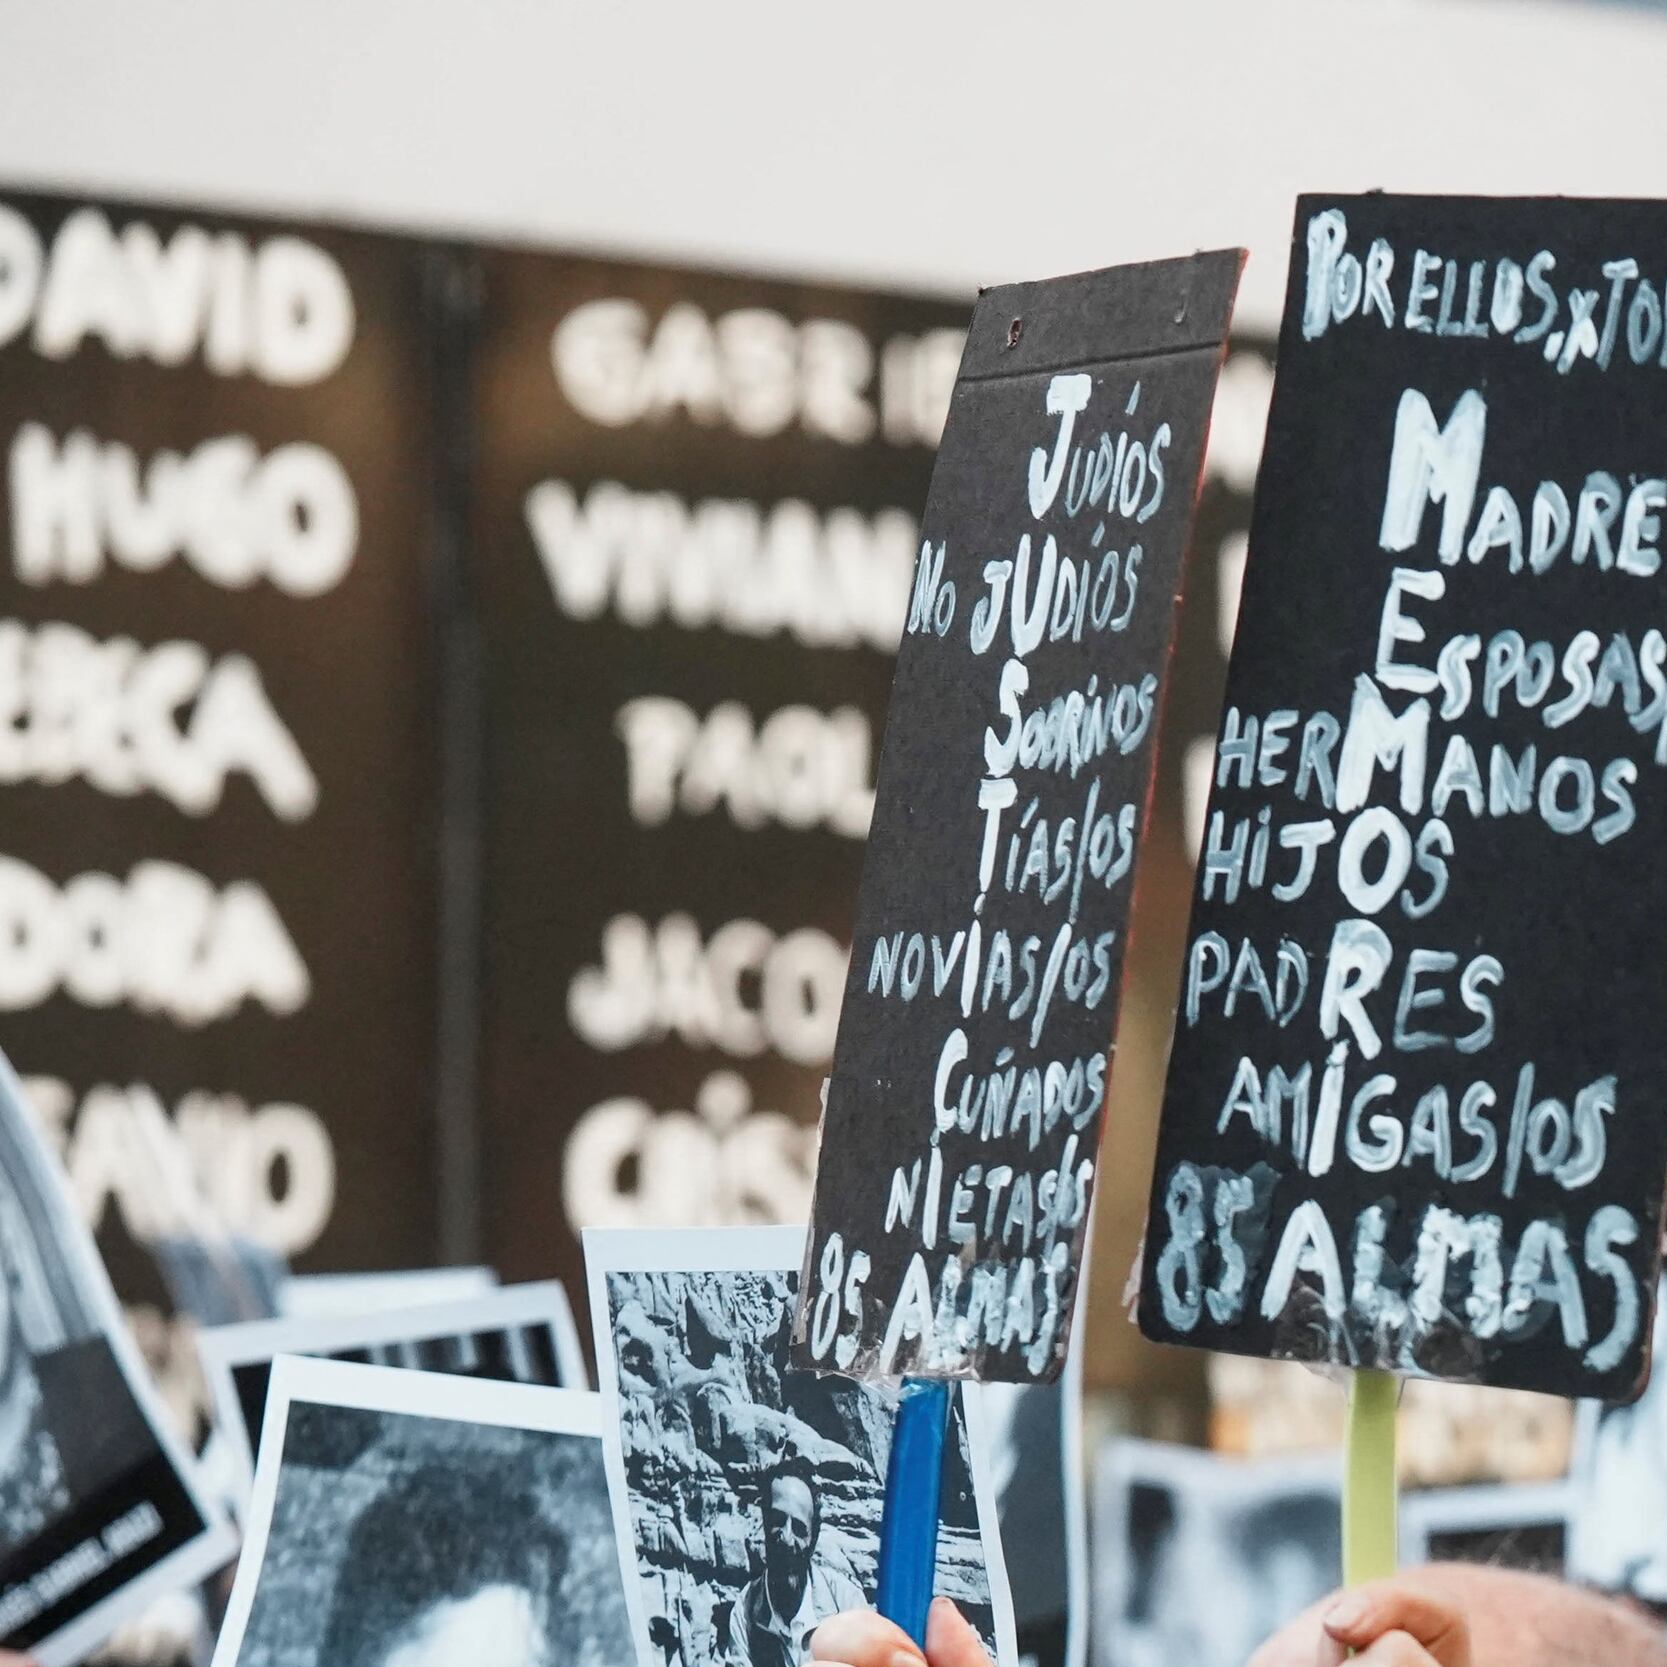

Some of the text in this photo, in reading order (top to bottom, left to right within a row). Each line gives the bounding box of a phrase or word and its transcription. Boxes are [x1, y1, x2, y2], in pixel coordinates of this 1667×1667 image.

[10, 422, 360, 598] HUGO
[1216, 673, 1638, 845] HERMANOS
[1186, 917, 1504, 1060] PADRES
[811, 1232, 871, 1369] 85
[1156, 1161, 1640, 1373] 85 ALMAS
